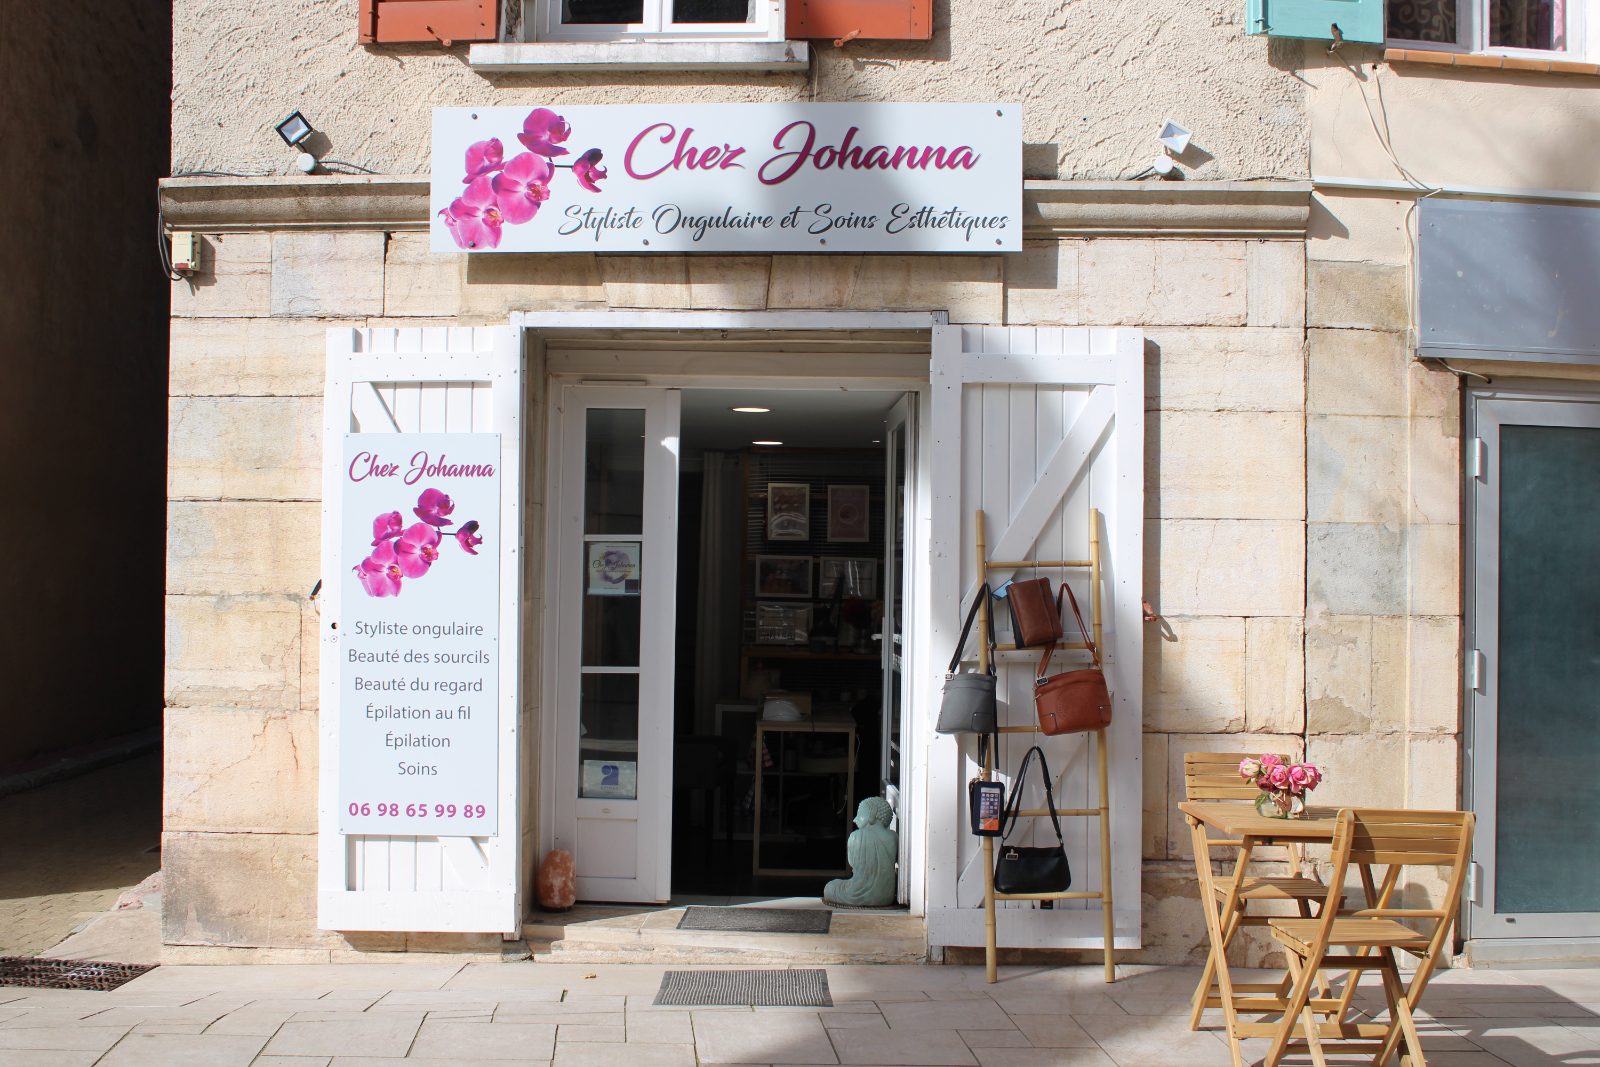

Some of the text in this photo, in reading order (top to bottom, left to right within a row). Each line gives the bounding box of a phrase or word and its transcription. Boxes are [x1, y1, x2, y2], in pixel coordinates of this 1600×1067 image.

[623, 120, 982, 186] Chez Johanna
[558, 202, 1011, 243] Styliste Ongulaire et Soins Esthétiques
[349, 450, 496, 485] Chez Johanna
[355, 620, 484, 639] Styliste ongulaire
[348, 648, 490, 664] Beauté des sourcils
[354, 676, 483, 696] Beauté du regard
[366, 702, 471, 722] Épilation au fil
[385, 731, 451, 750] Épilation
[398, 761, 438, 776] Soins
[348, 802, 486, 819] 06 98 65 99 89
